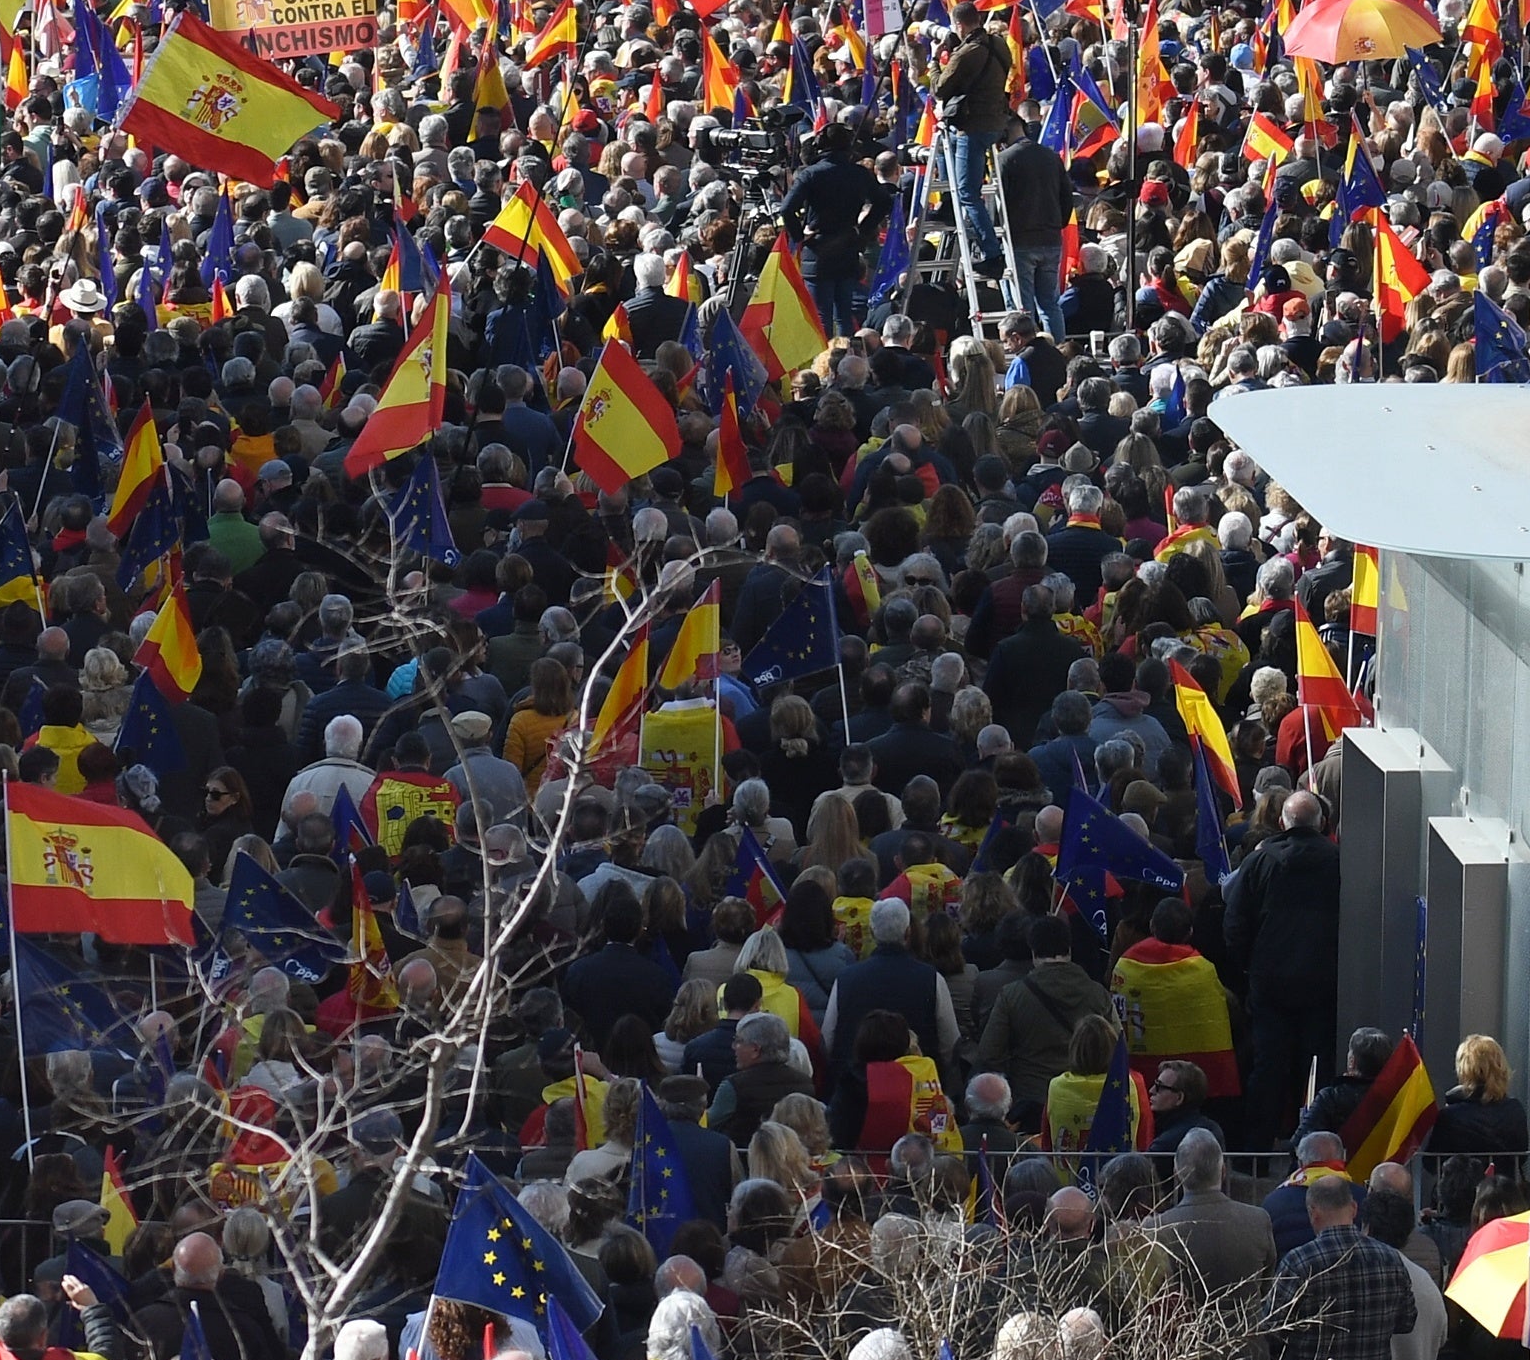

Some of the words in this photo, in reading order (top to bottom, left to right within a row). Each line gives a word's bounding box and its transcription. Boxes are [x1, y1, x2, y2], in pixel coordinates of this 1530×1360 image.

[273, 2, 347, 25] CONTRA
[352, 0, 375, 17] EL
[296, 967, 320, 982] ppe
